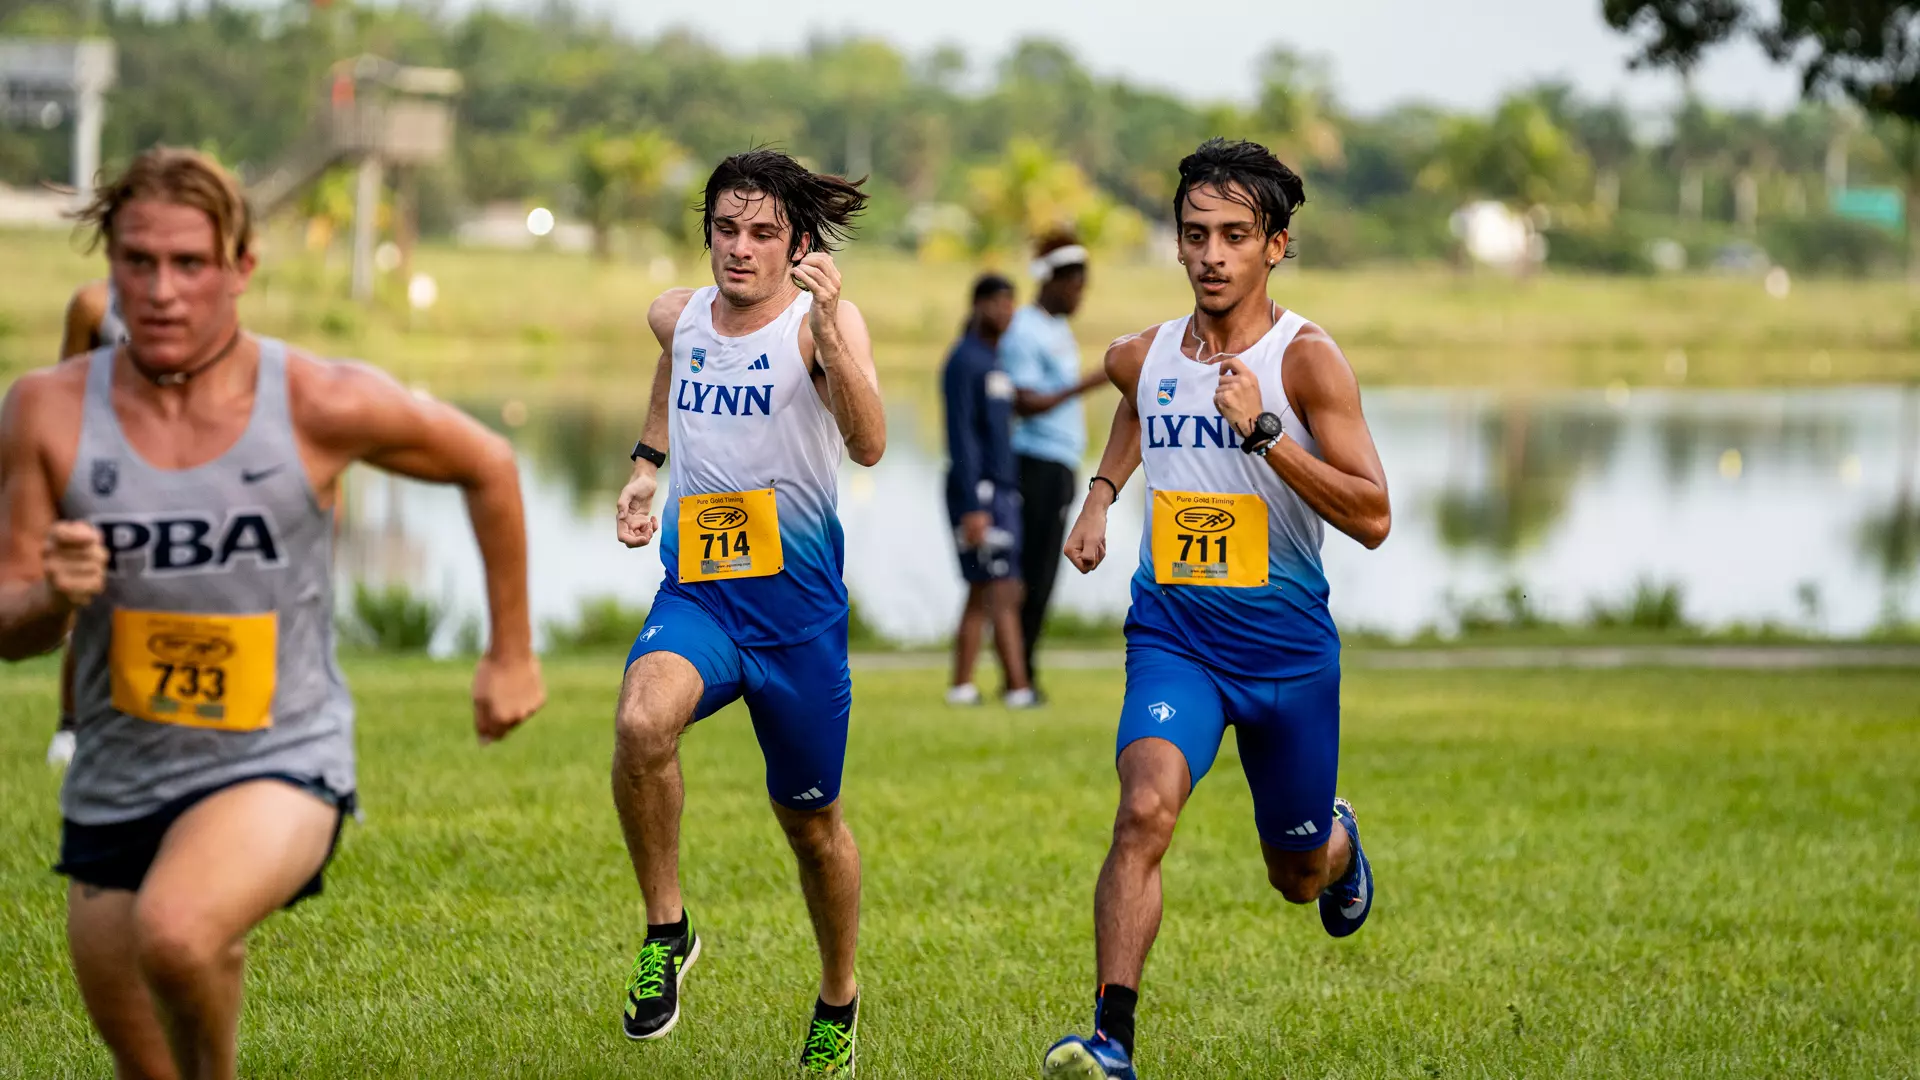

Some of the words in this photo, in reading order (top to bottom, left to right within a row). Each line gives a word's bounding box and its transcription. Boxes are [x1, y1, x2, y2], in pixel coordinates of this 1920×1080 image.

[677, 379, 775, 416] LYNN
[724, 496, 744, 504] Timing
[1176, 495, 1192, 503] Pure
[1193, 496, 1210, 504] Gold
[1211, 497, 1235, 507] Timing
[95, 514, 281, 573] PBA
[700, 531, 750, 559] 714
[1177, 534, 1227, 563] 711
[151, 661, 226, 701] 733
